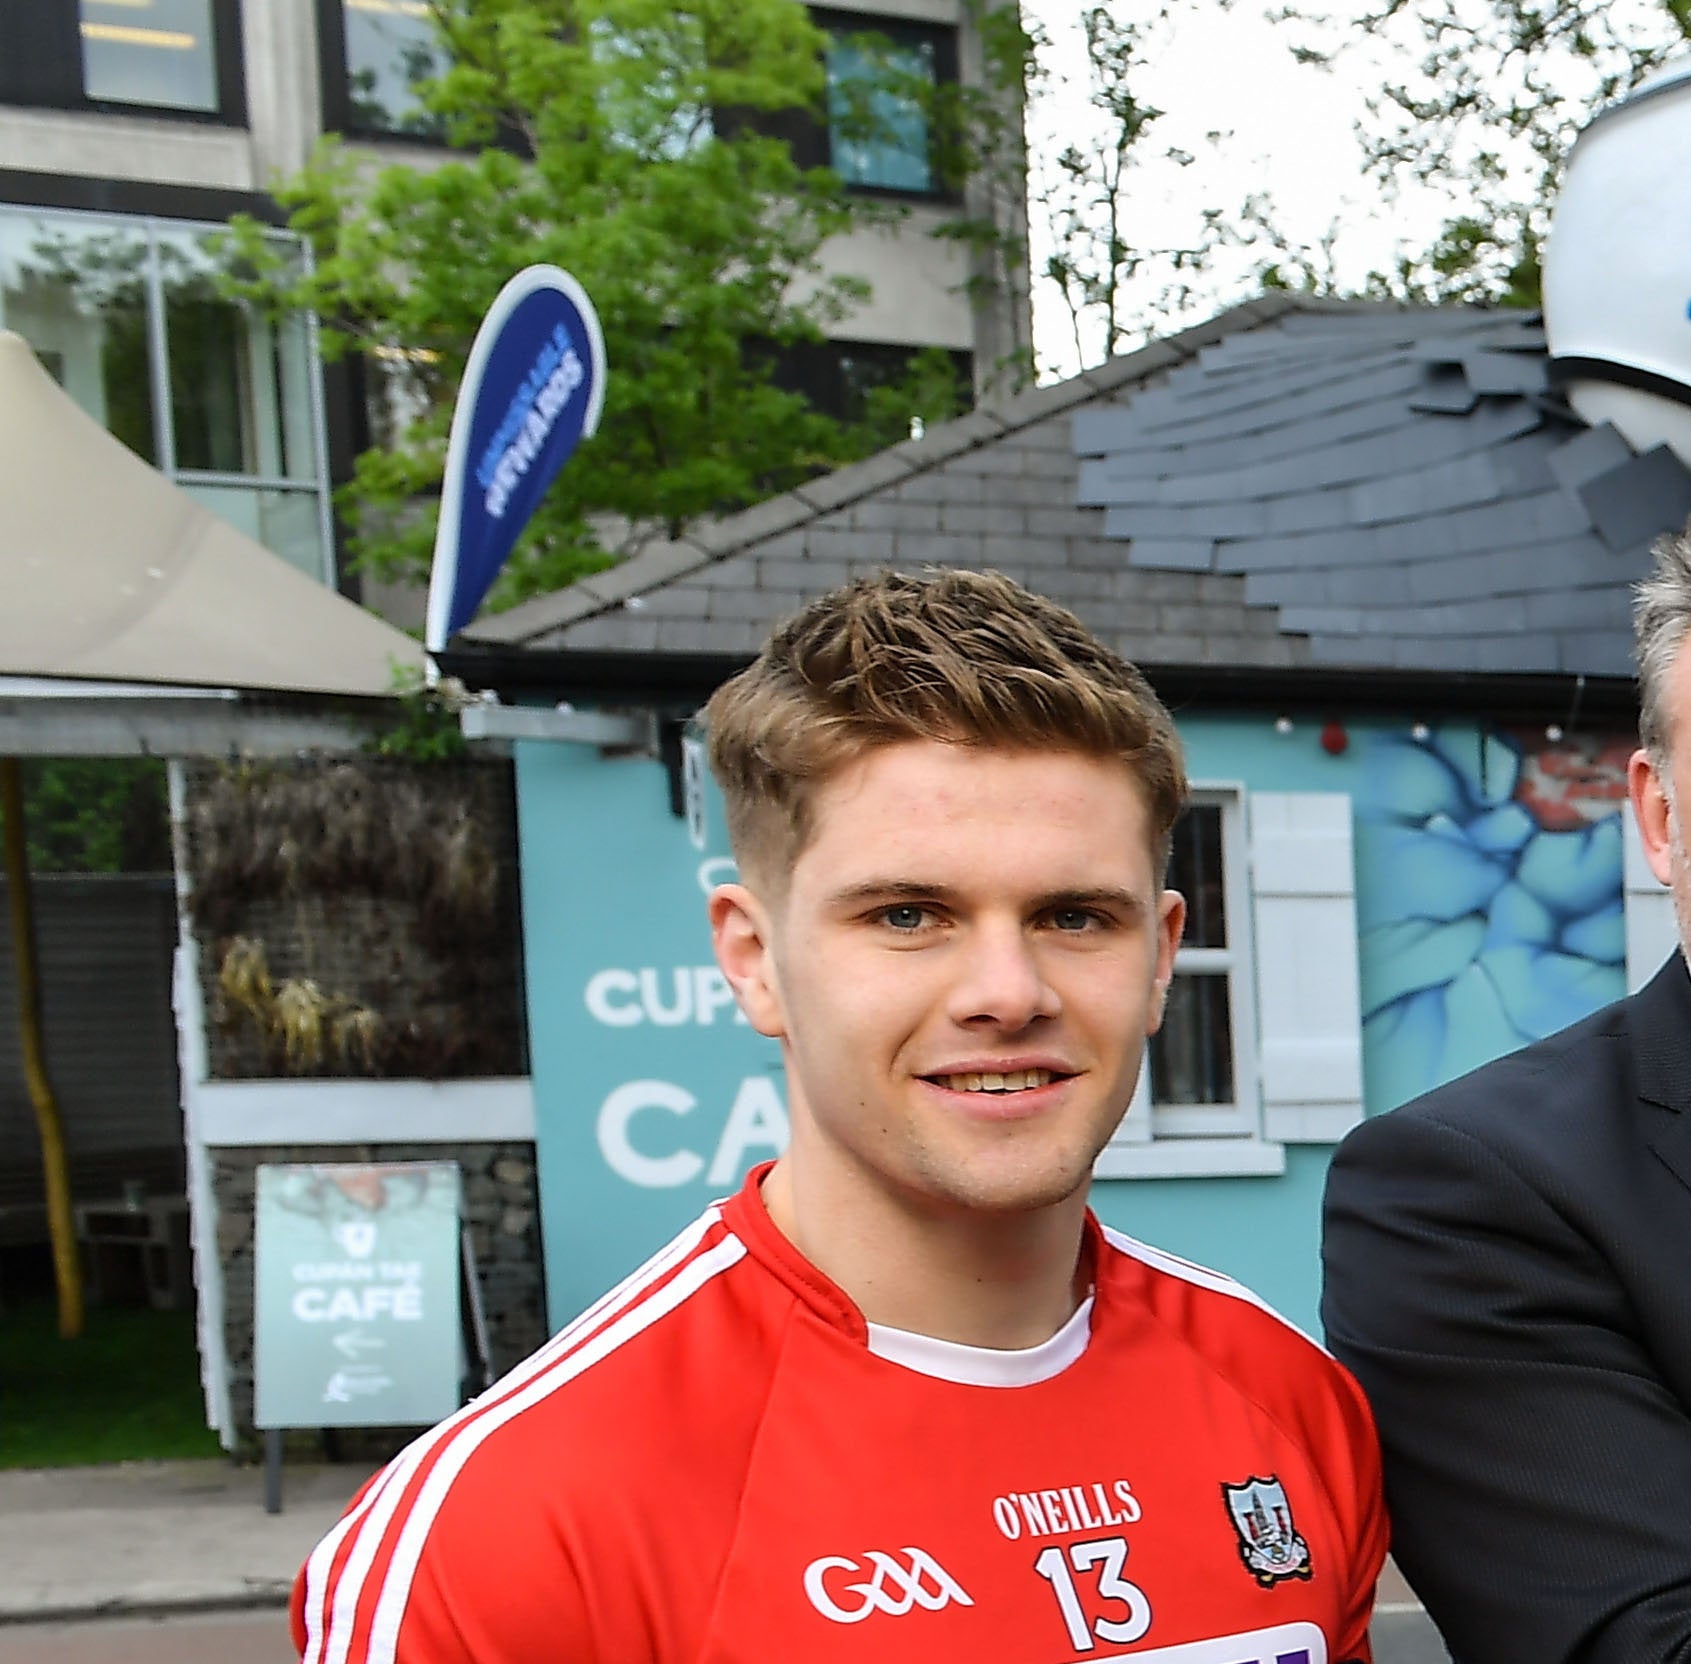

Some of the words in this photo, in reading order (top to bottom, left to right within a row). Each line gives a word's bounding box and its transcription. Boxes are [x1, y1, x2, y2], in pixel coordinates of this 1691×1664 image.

[584, 968, 750, 1027] CUP
[597, 1077, 792, 1188] CA
[292, 1281, 423, 1322] CAFÉ
[992, 1480, 1142, 1541] O'NEILLS
[804, 1547, 974, 1624] GAA
[1032, 1537, 1152, 1651] 13
